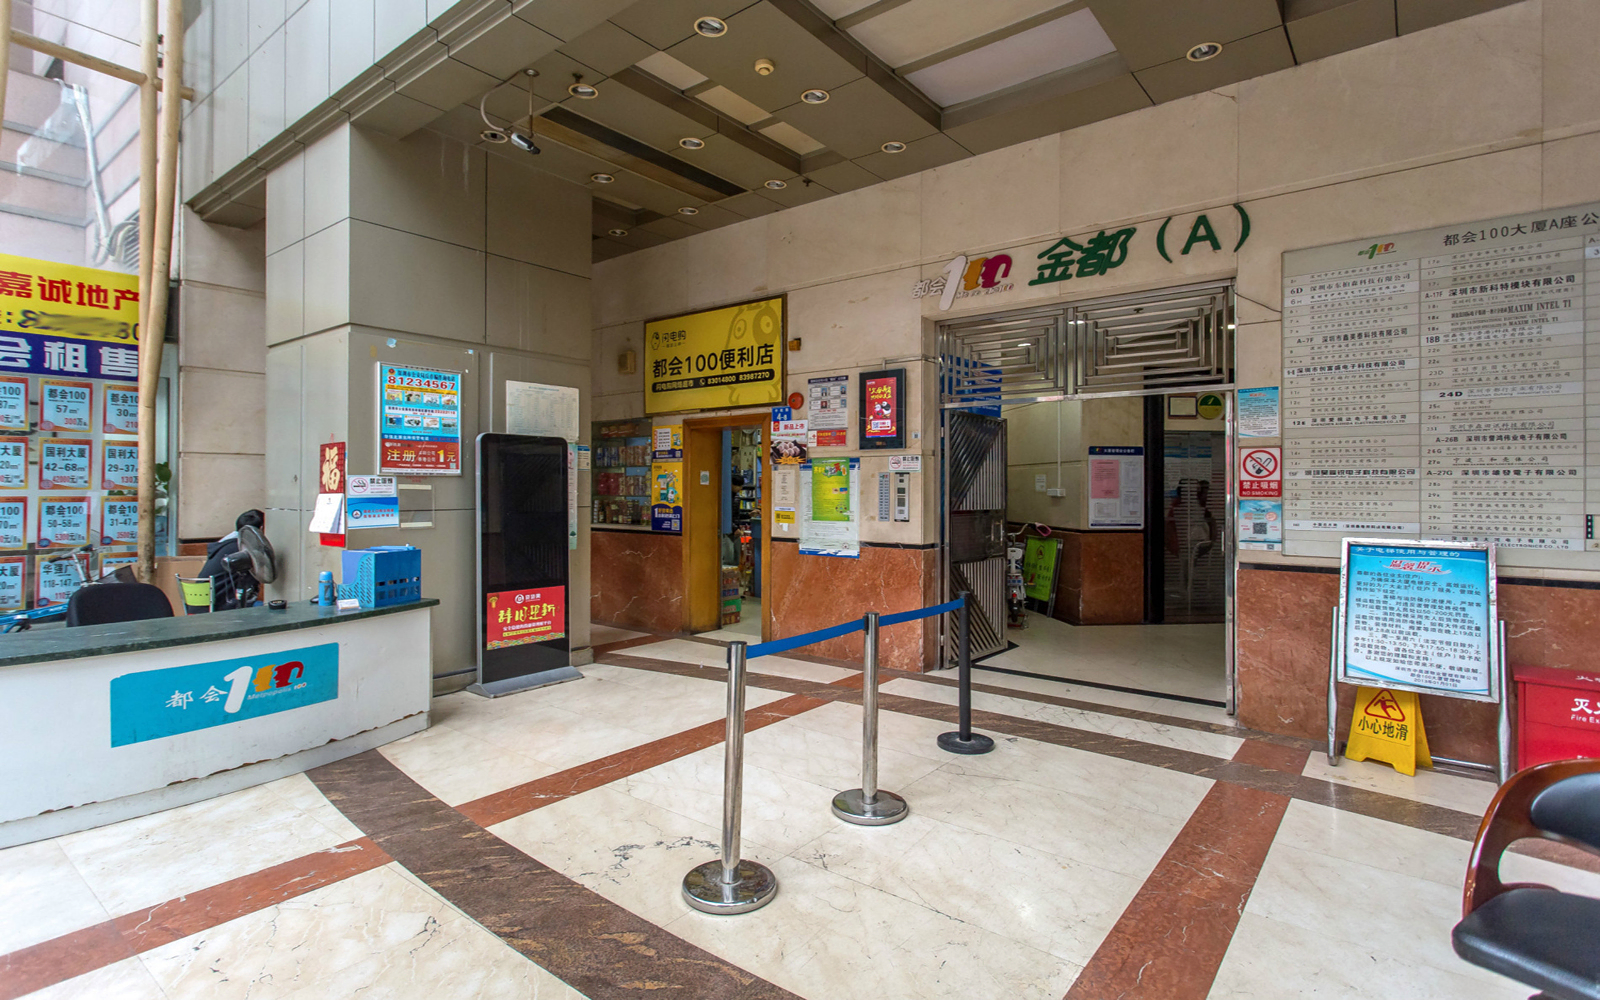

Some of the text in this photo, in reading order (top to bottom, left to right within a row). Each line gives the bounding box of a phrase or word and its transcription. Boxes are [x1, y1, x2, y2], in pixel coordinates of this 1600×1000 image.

[1028, 227, 1137, 286] 金都
[0, 271, 139, 310] 嘉诚地产
[1290, 287, 1303, 295] 6D
[1425, 274, 1576, 299] A-17F 深圳市新科特模块有限公司
[1507, 302, 1534, 314] MAXIM
[1536, 299, 1560, 311] INTEL
[1563, 299, 1572, 308] TI
[661, 330, 687, 342] 闪电购
[653, 344, 774, 378] 都会100便利店
[387, 376, 456, 391] 81234567
[48, 388, 87, 400] 都会100
[45, 446, 87, 458] 国利大厦
[107, 448, 138, 460] 国利大
[387, 449, 416, 462] 注册
[321, 446, 341, 492] 福
[1242, 481, 1279, 490] 禁止吸烟
[46, 505, 84, 516] 都会100
[1356, 547, 1461, 558] 关于电梯使用与管理的
[1389, 559, 1442, 573] 温馨提示
[1571, 714, 1587, 722] Fire
[1358, 716, 1409, 741] 小心地滑
